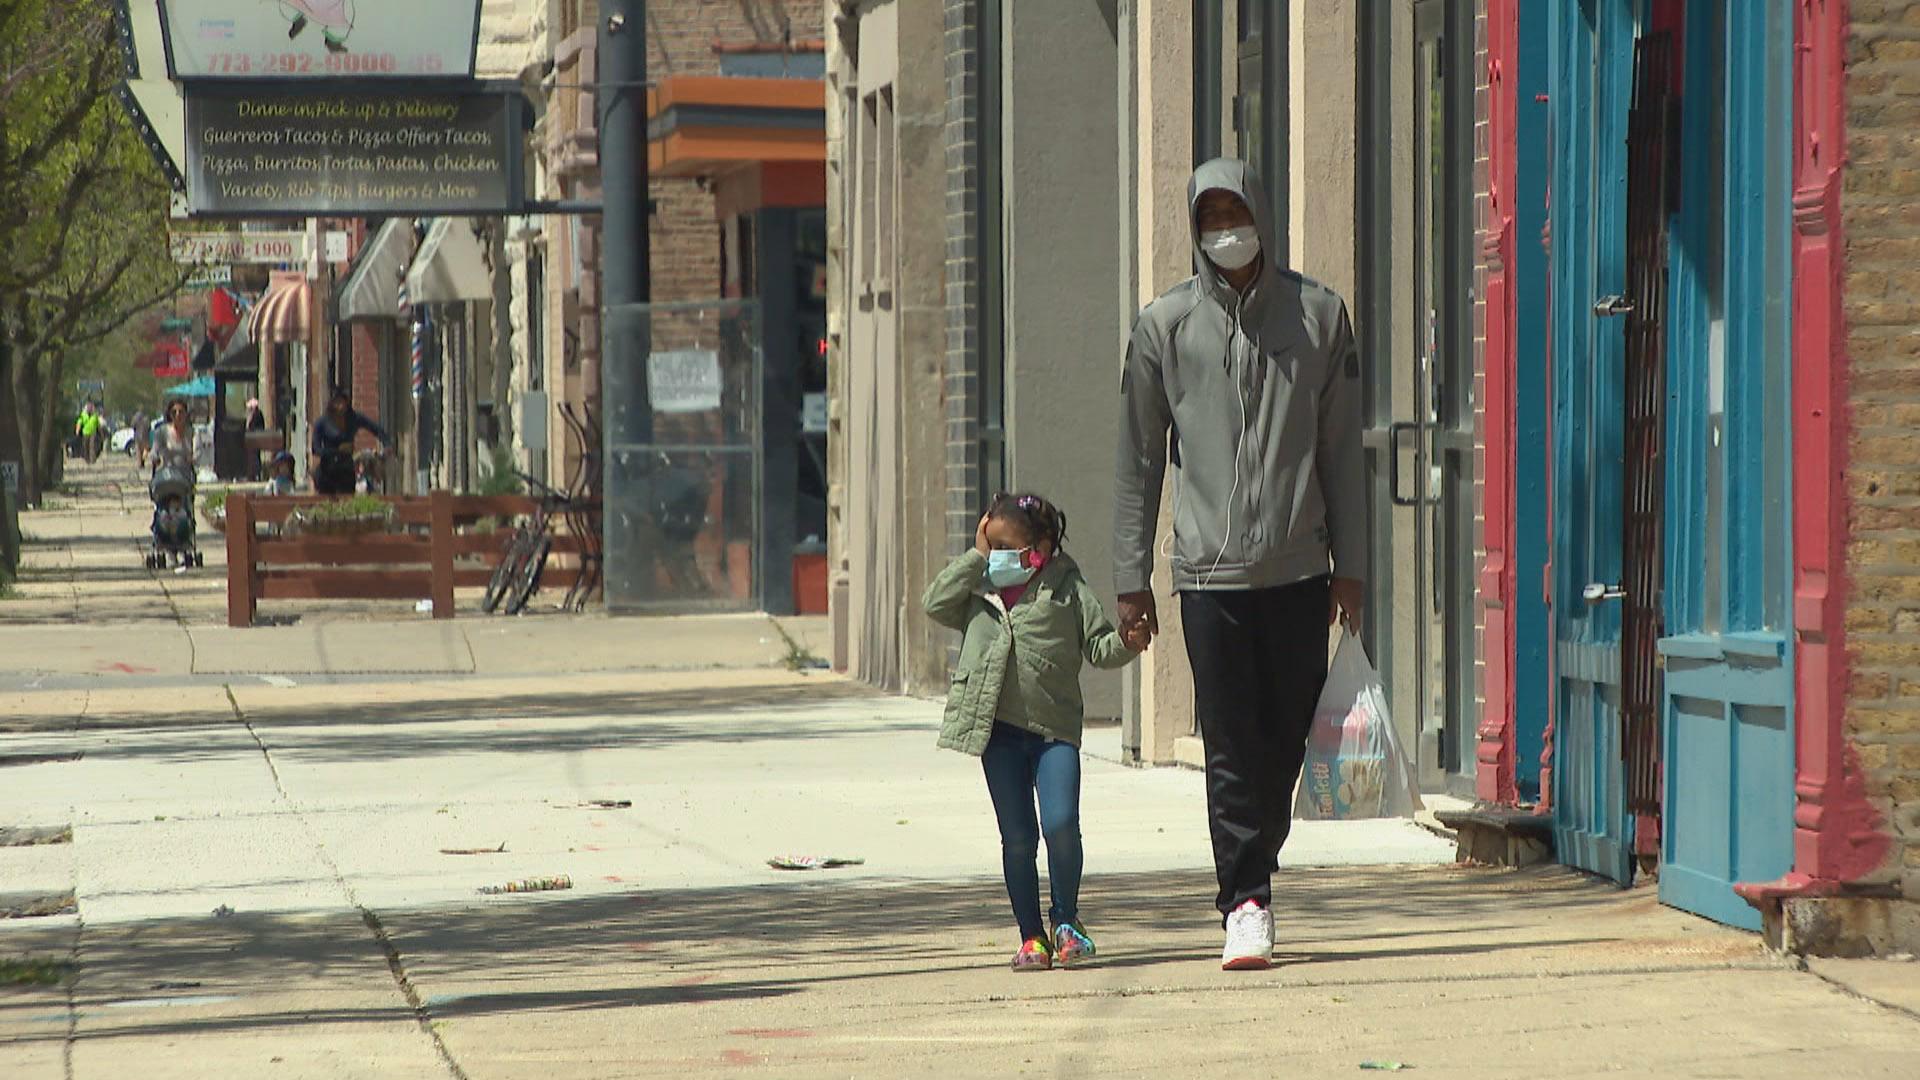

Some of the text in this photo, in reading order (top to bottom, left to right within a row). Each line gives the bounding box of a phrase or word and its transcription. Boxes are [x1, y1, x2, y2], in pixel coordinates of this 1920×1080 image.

[396, 101, 458, 121] Delivery
[203, 127, 280, 146] Guerreros
[348, 127, 395, 149] Pizza
[396, 126, 442, 148] Offers
[201, 154, 249, 176] Pizza,
[433, 153, 499, 172] Chicken
[220, 181, 283, 201] Variety,
[287, 180, 315, 198] Rib
[358, 181, 421, 201] Burgers
[439, 181, 478, 199] More
